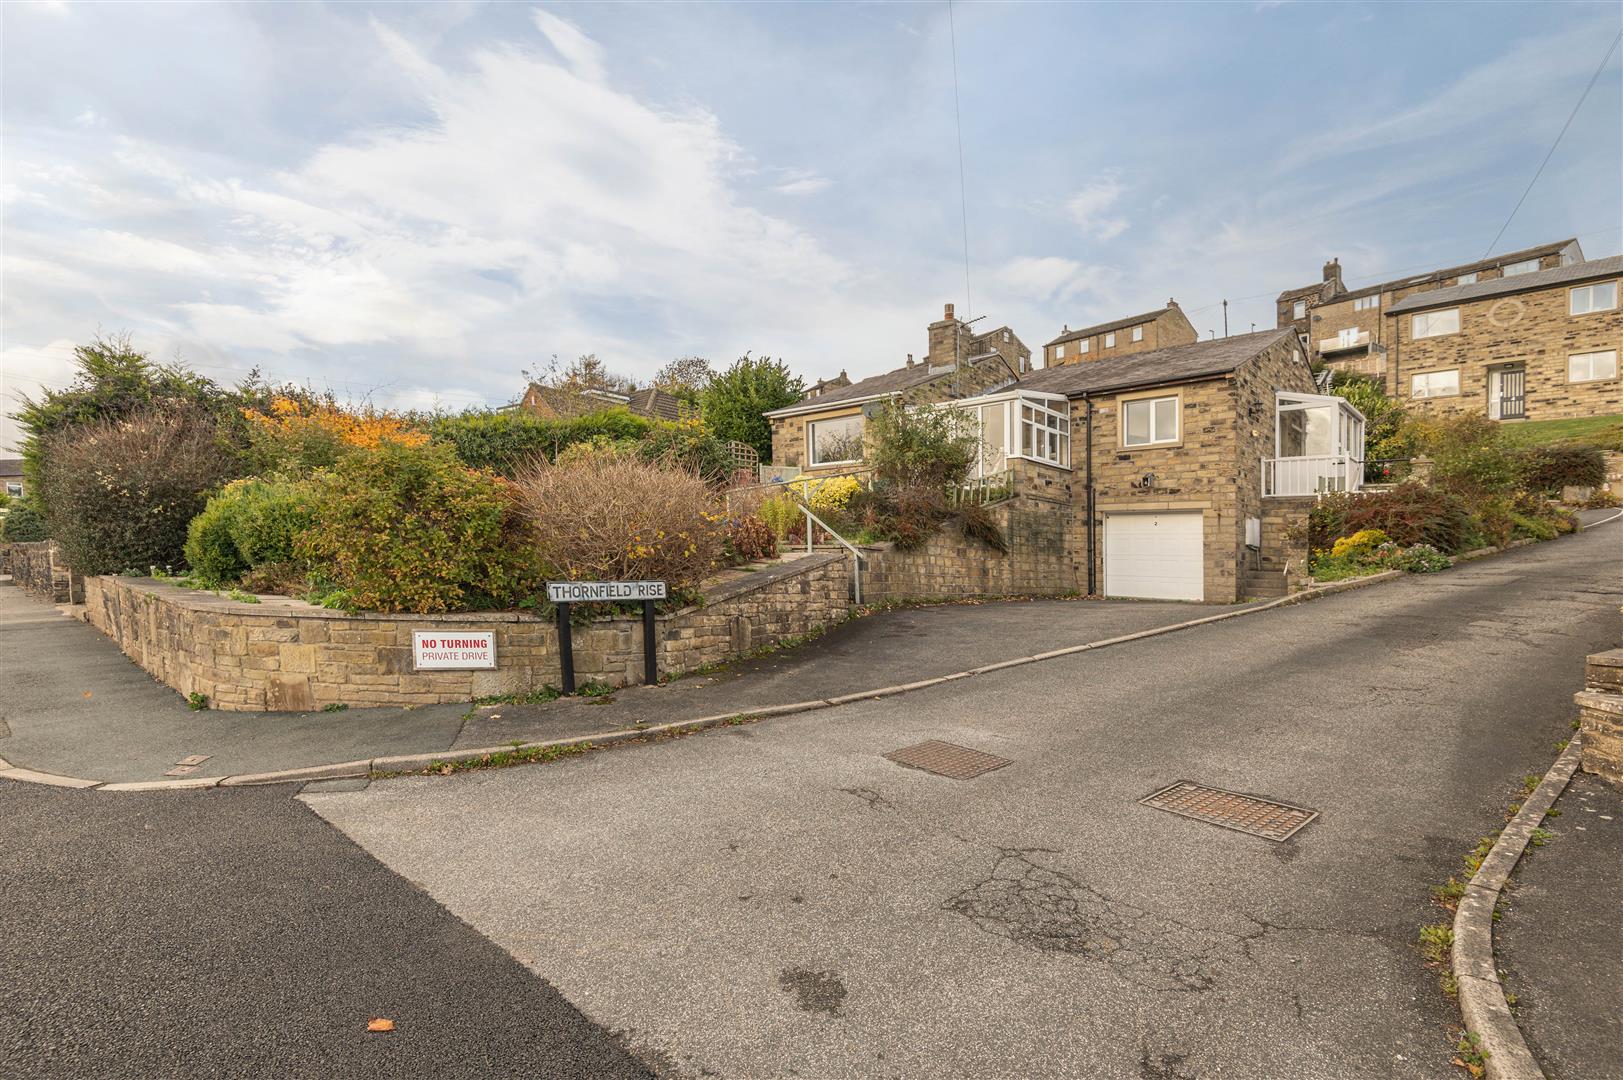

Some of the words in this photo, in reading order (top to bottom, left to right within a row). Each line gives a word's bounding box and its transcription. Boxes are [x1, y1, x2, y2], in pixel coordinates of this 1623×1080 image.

[552, 585, 632, 599] THORNFIELD
[638, 584, 663, 596] RISE
[421, 639, 437, 649] NO
[440, 639, 488, 649] TURNING
[422, 651, 459, 661] PRIVATE
[461, 651, 489, 661] DRIVE
